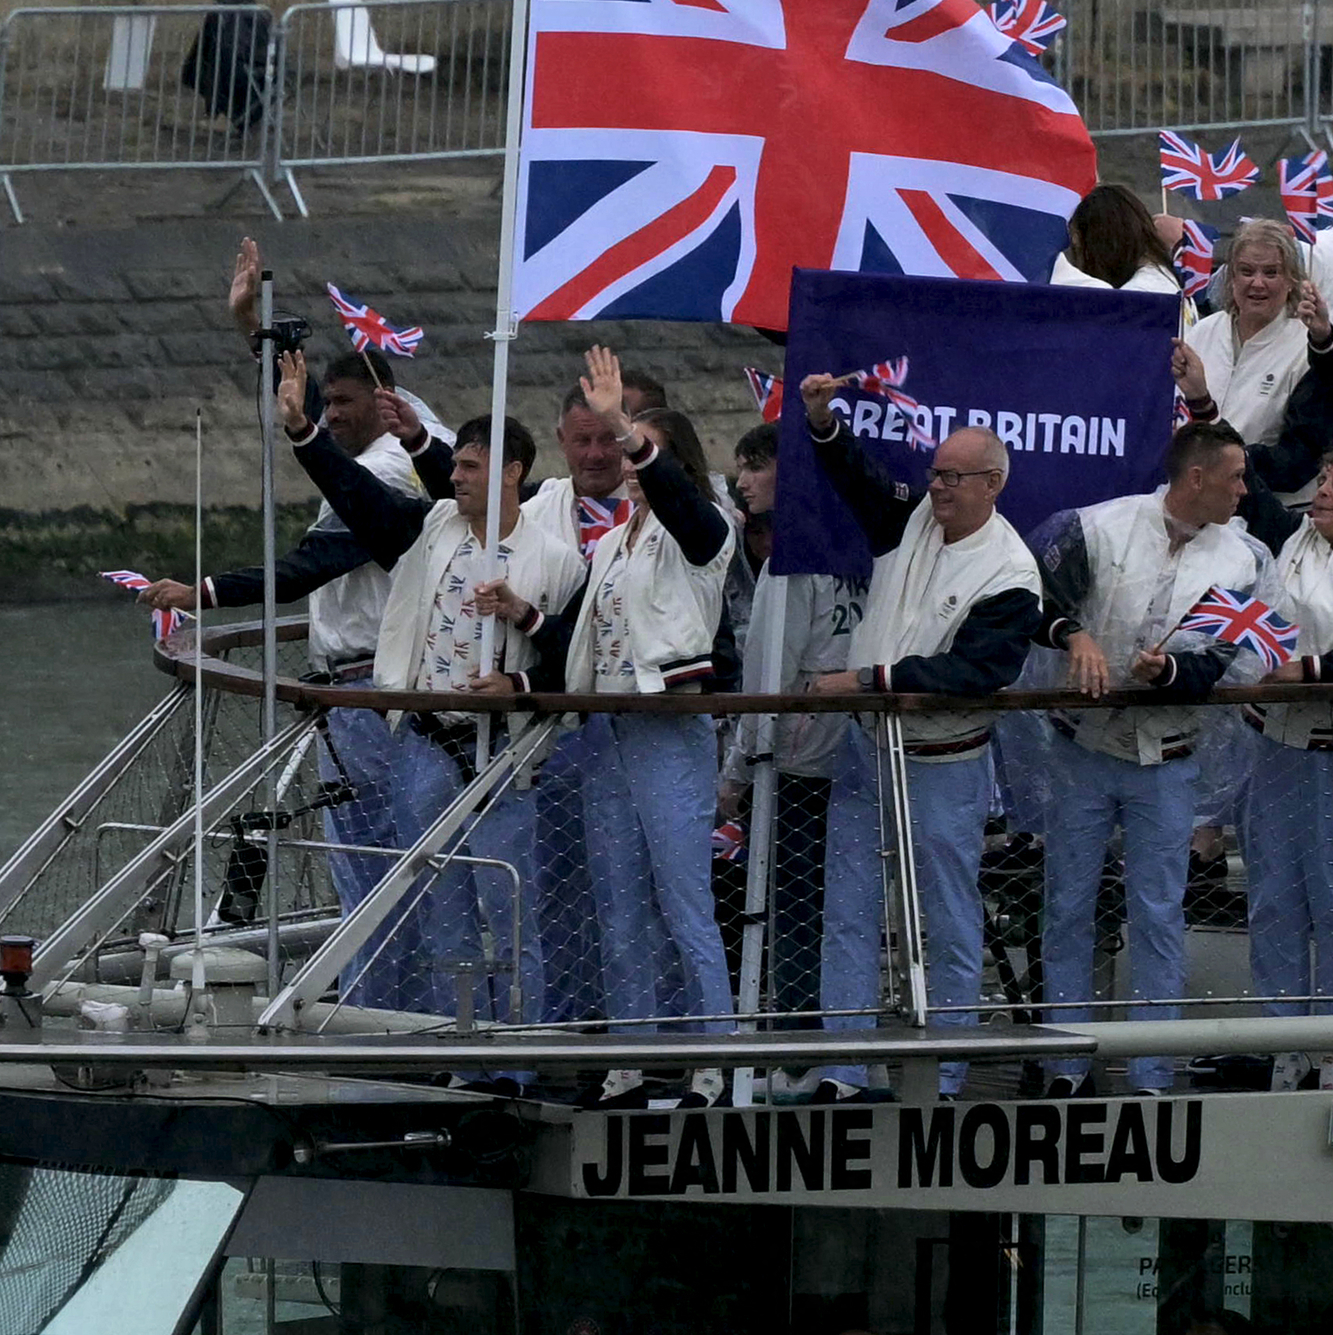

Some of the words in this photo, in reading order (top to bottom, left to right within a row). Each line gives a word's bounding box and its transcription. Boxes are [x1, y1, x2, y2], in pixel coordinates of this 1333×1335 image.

[828, 397, 956, 444] GREAT
[968, 409, 1125, 456] BRITAIN
[582, 1109, 873, 1196] JEANNE
[898, 1100, 1202, 1188] MOREAU
